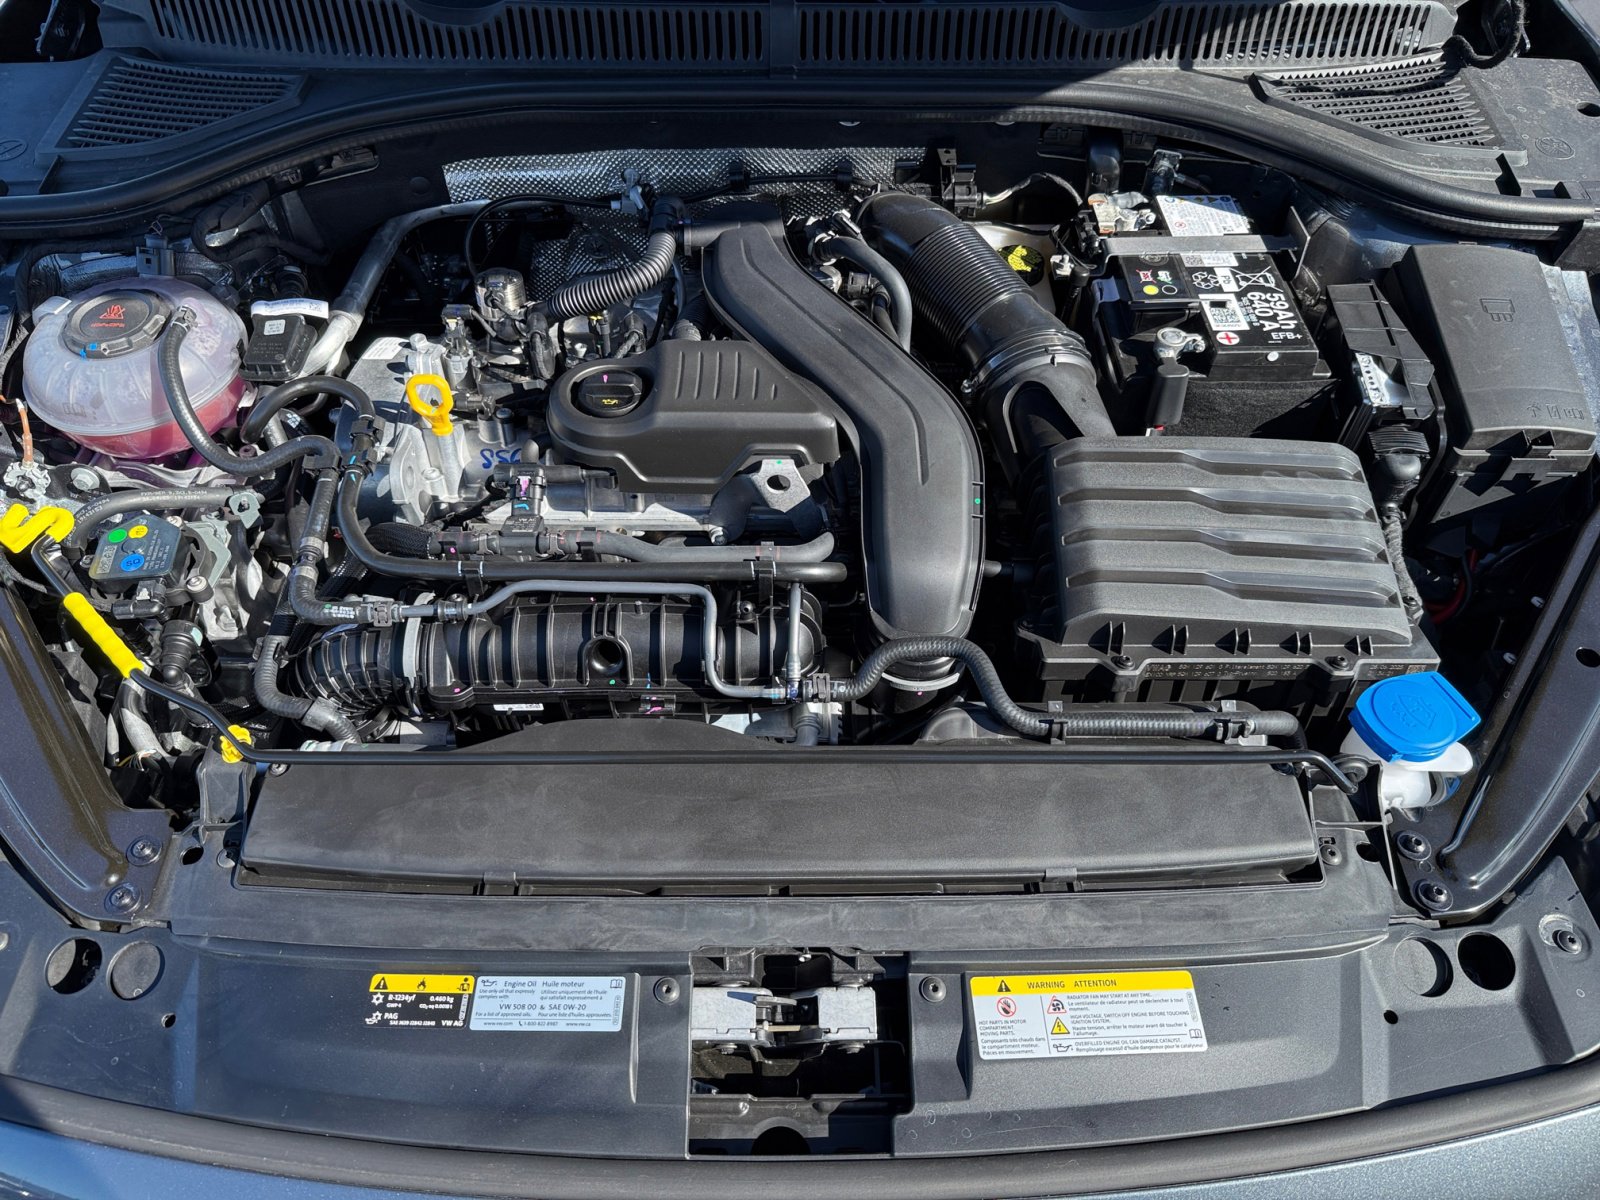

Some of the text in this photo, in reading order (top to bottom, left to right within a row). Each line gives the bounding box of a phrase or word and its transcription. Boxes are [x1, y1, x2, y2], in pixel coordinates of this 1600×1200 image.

[1247, 292, 1274, 317] 640
[1266, 292, 1298, 329] 59Ah
[1260, 320, 1280, 332] A
[1027, 980, 1066, 989] WARNING
[1074, 979, 1117, 988] ATTENTION
[388, 994, 416, 1003] R-1234yf
